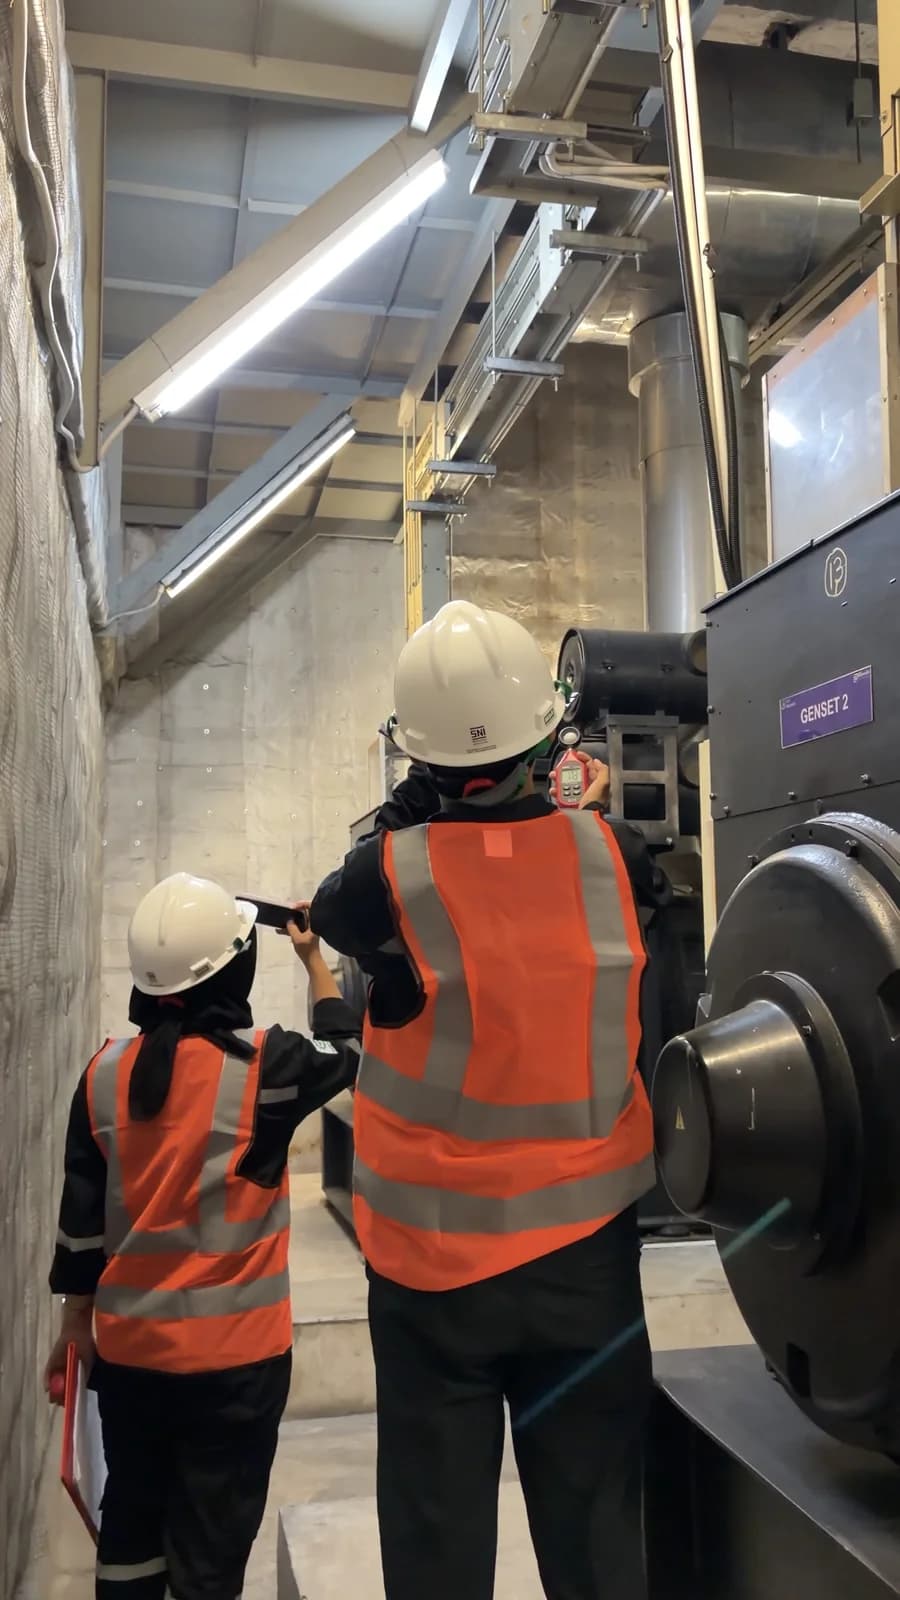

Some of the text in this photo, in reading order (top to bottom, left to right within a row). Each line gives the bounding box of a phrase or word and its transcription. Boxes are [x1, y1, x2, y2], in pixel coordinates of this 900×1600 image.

[800, 696, 840, 724] GENSET
[842, 693, 849, 711] 2
[470, 726, 486, 738] SNI
